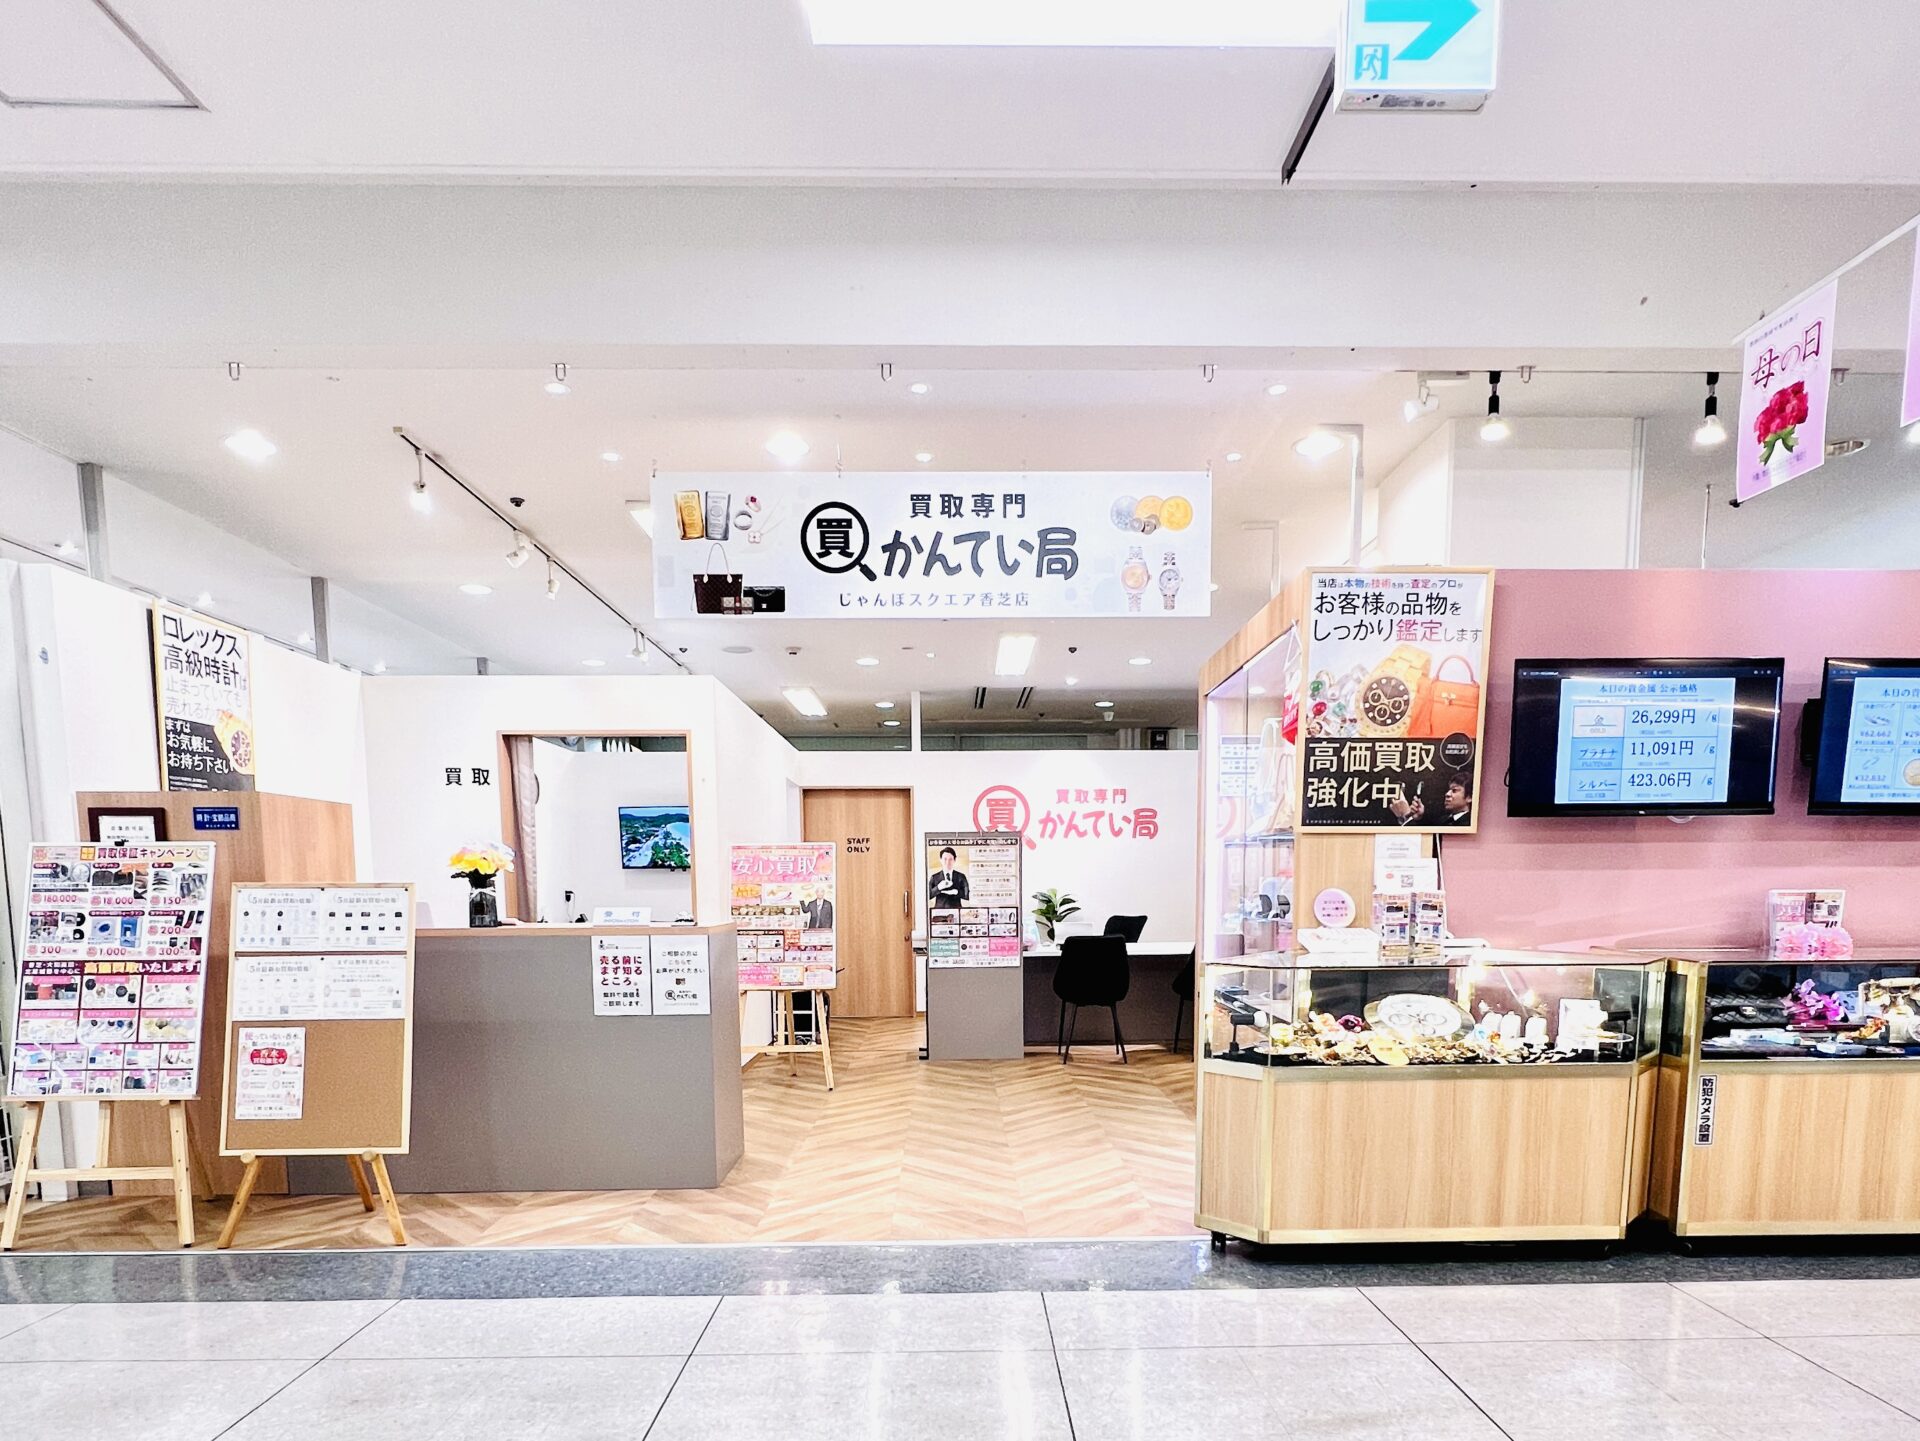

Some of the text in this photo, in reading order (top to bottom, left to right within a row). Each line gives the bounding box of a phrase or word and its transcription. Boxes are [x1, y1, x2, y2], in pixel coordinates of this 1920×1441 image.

[1751, 320, 1823, 388] 母の日
[909, 493, 1027, 520] 買取専門
[815, 517, 855, 558] 買
[880, 527, 1080, 582] かんてい局
[838, 591, 1031, 607] じゃんぼスクエア香芝店
[1314, 592, 1462, 616] お客様の品物を
[162, 614, 242, 659] ロレックス
[1314, 618, 1483, 642] しっかり鑑定します
[162, 643, 248, 691] 高級時計は
[165, 718, 192, 733] まずは
[1631, 708, 1717, 725] 26,299円 /g
[166, 732, 214, 753] お気軽に
[1579, 748, 1617, 758] プラチナ
[1631, 740, 1715, 757] 11,091円 /g
[167, 752, 235, 775] お持ち下さい
[1308, 741, 1436, 773] 高価買取
[445, 767, 491, 786] 買取
[1578, 779, 1617, 789] シルバー
[1627, 772, 1713, 788] 423.06円 /g
[1056, 788, 1128, 805] 買取専門
[1306, 777, 1401, 809] 強化中
[986, 797, 1017, 832] 買
[1037, 807, 1160, 840] かんてい局
[846, 837, 871, 845] STAFF
[97, 847, 194, 859] 買取保証キャンペーン
[734, 856, 817, 876] 安心買取
[599, 955, 643, 965] 売る前に
[600, 966, 643, 976] まず知る
[1698, 1077, 1714, 1143] 防犯カメラ設置
